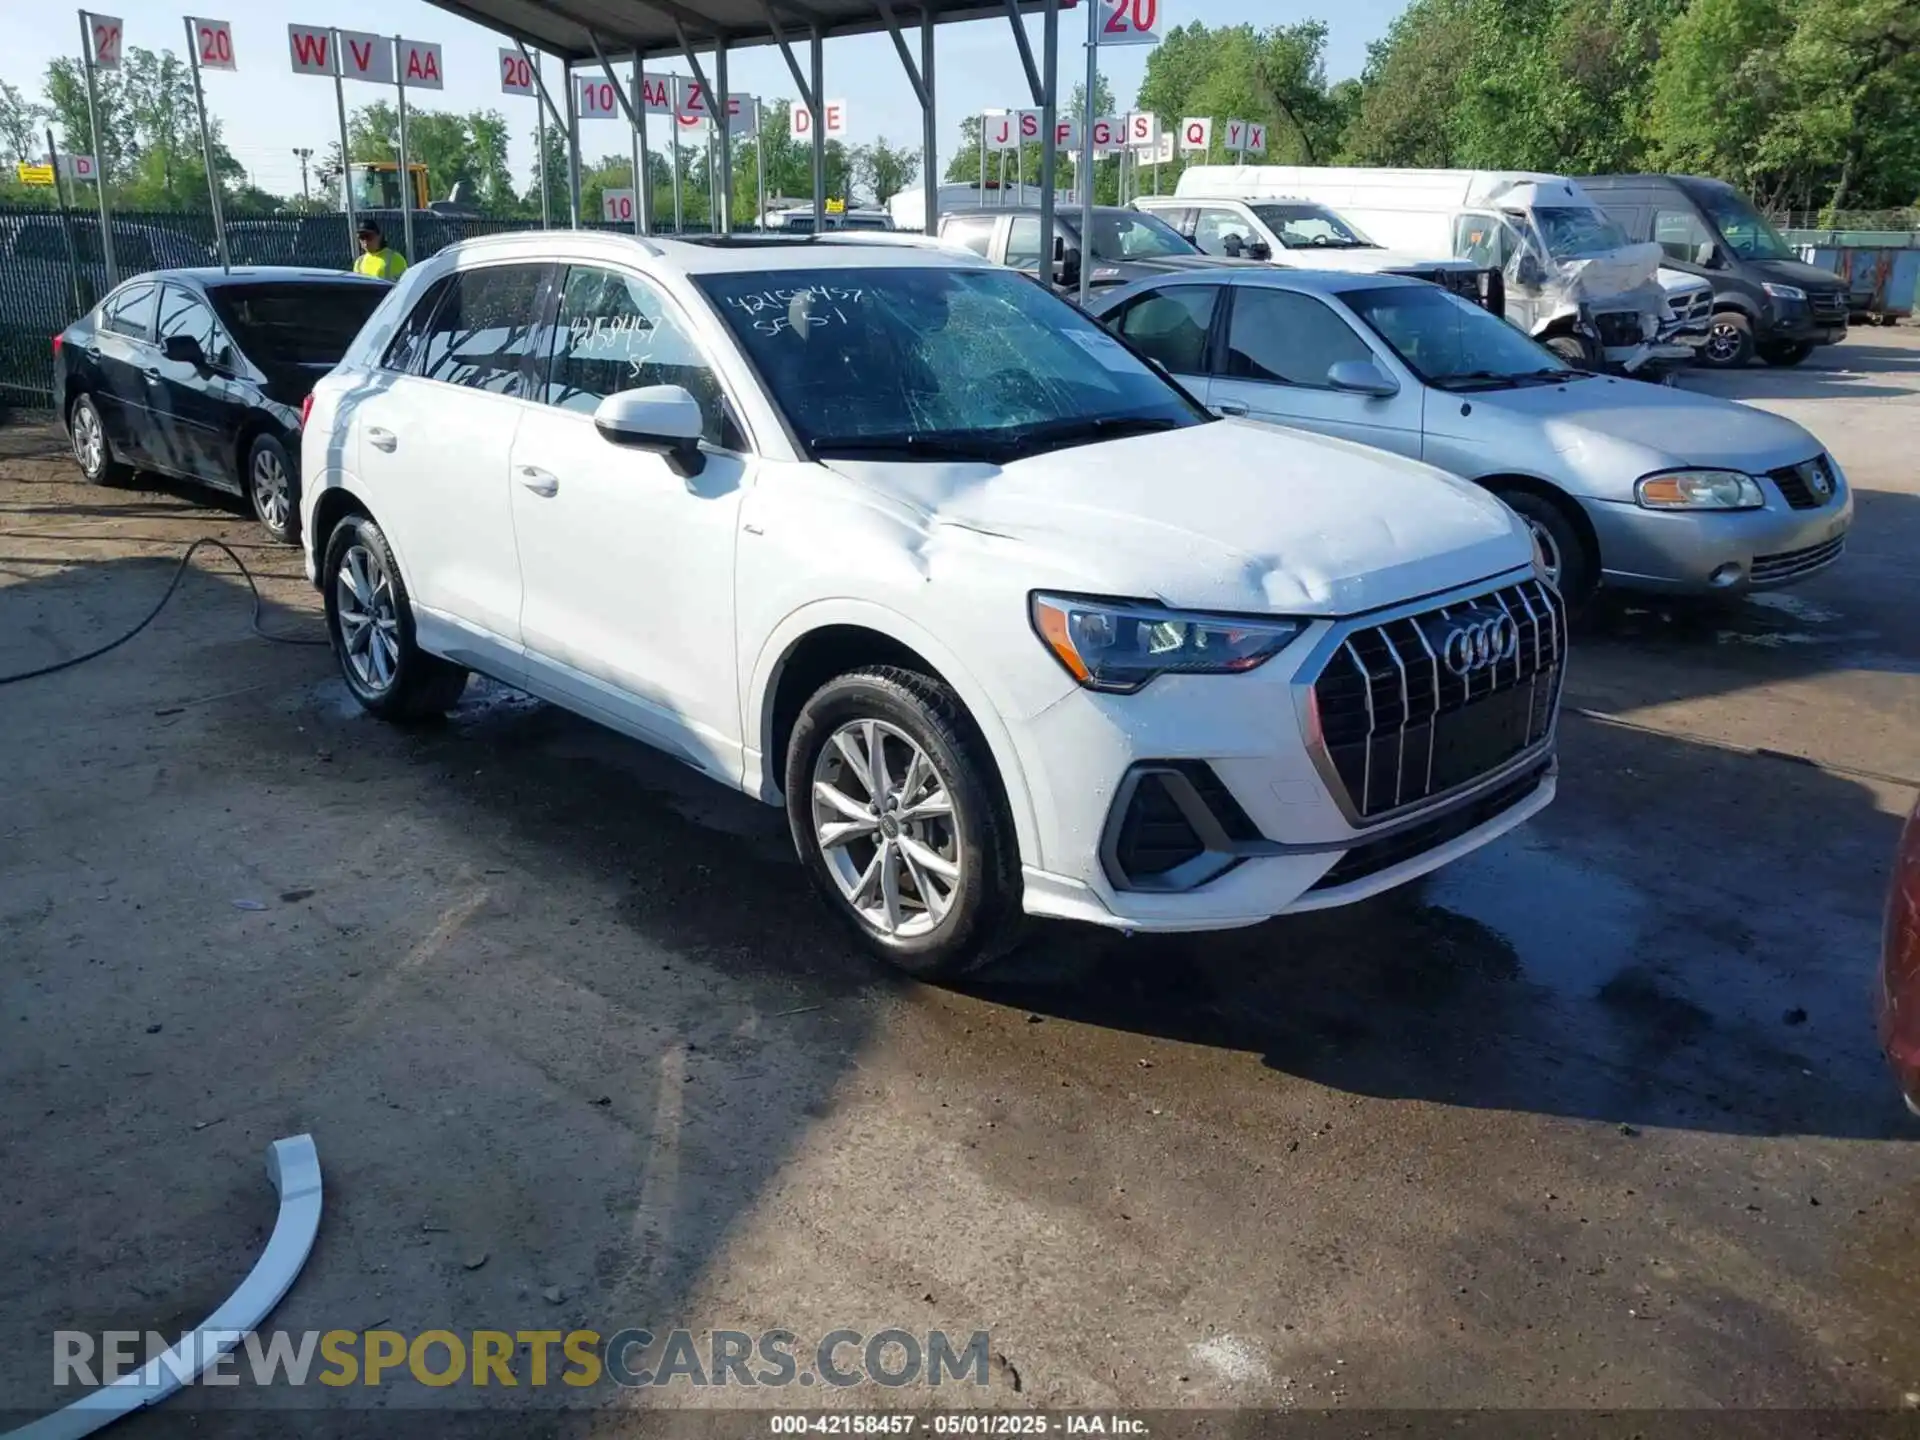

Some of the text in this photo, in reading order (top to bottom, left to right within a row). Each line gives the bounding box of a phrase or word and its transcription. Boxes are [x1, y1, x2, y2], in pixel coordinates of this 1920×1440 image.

[1103, 0, 1157, 33] 20
[201, 27, 232, 62] 20
[292, 33, 327, 68] W
[348, 39, 372, 72] V
[406, 48, 439, 82] AA
[503, 56, 531, 88] 20
[584, 83, 613, 111] 10
[686, 83, 704, 111] Z
[795, 109, 809, 132] D
[826, 106, 840, 130] E
[1022, 114, 1037, 136] S
[1135, 117, 1147, 138] S
[996, 121, 1009, 143] J
[1056, 124, 1071, 145] F
[1094, 123, 1110, 144] G
[1187, 123, 1204, 145] Q
[1230, 125, 1240, 144] Y
[1250, 127, 1261, 148] X
[605, 197, 631, 219] 10
